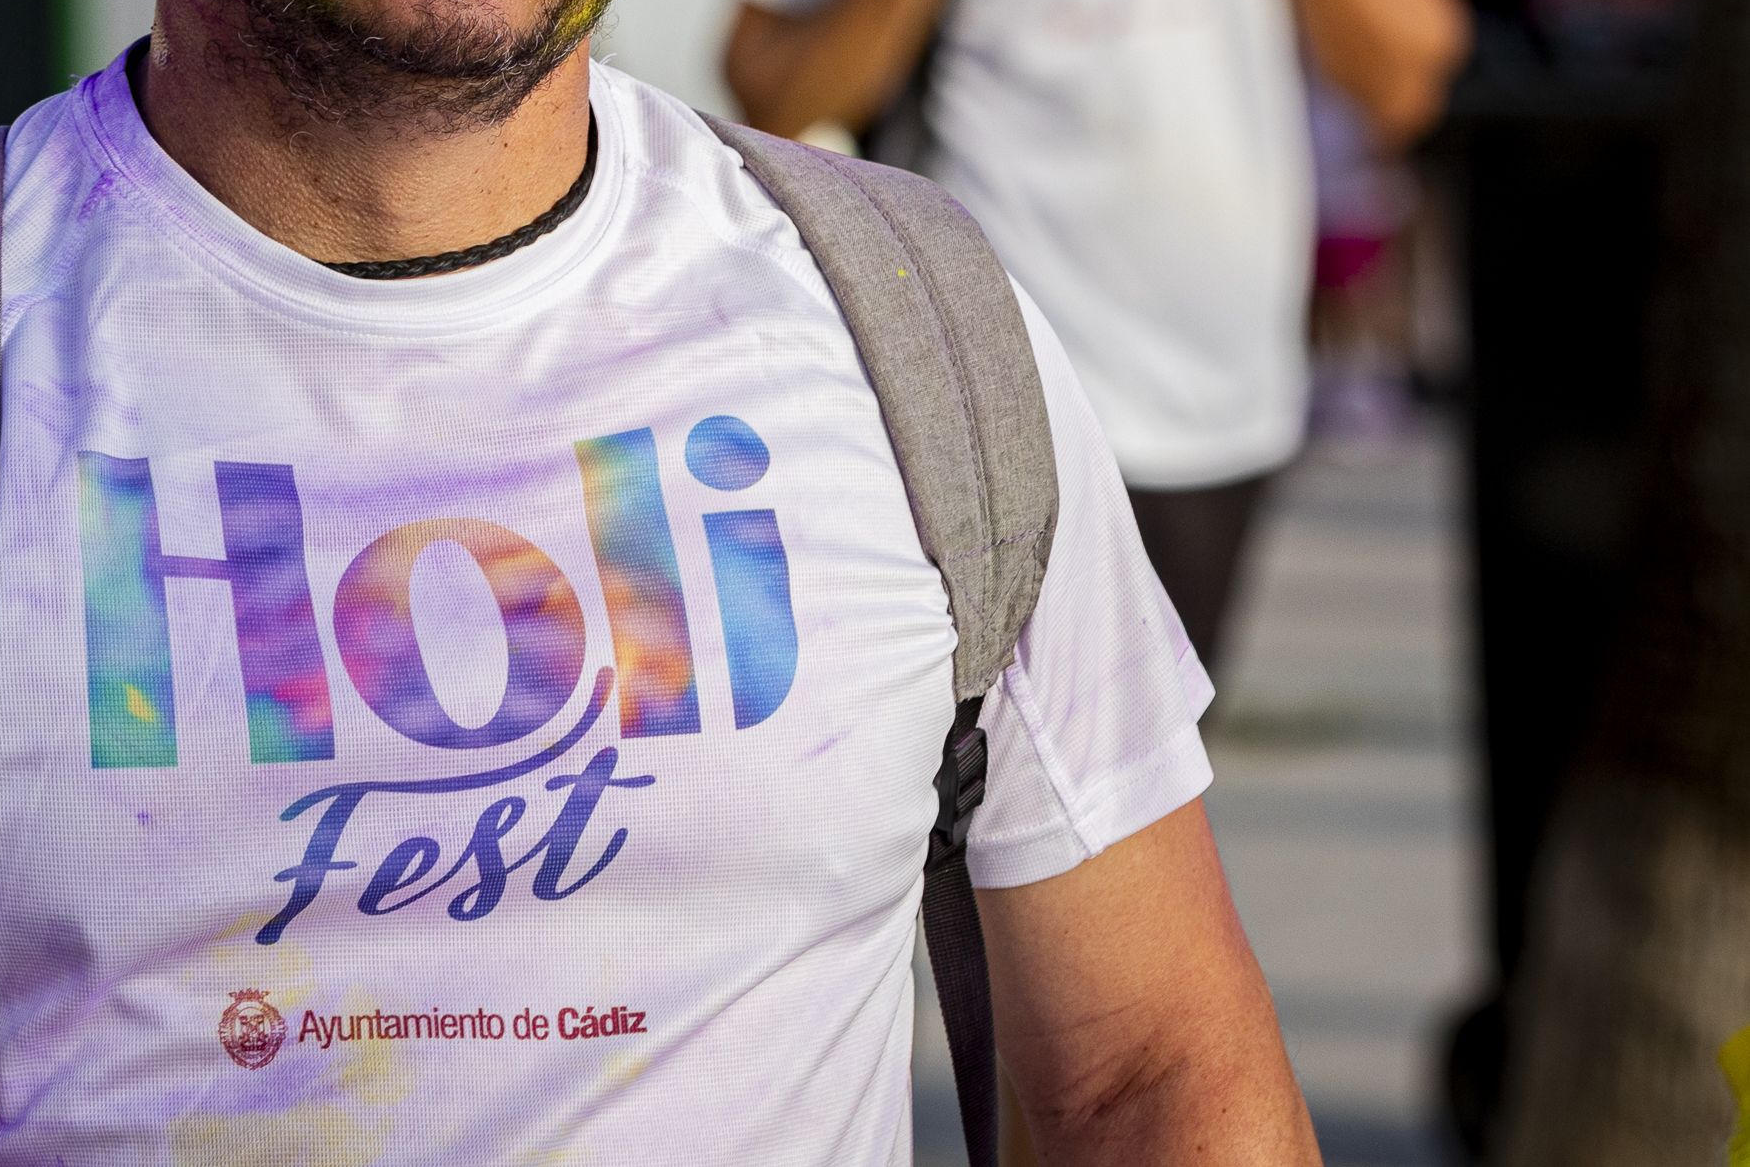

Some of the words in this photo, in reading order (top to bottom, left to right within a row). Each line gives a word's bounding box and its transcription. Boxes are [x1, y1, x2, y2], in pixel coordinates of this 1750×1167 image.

[76, 414, 801, 770] Holi
[254, 666, 656, 946] Fest
[298, 1007, 506, 1050] Ayuntamiento
[512, 1007, 550, 1041] de
[556, 1005, 648, 1041] Cádiz
